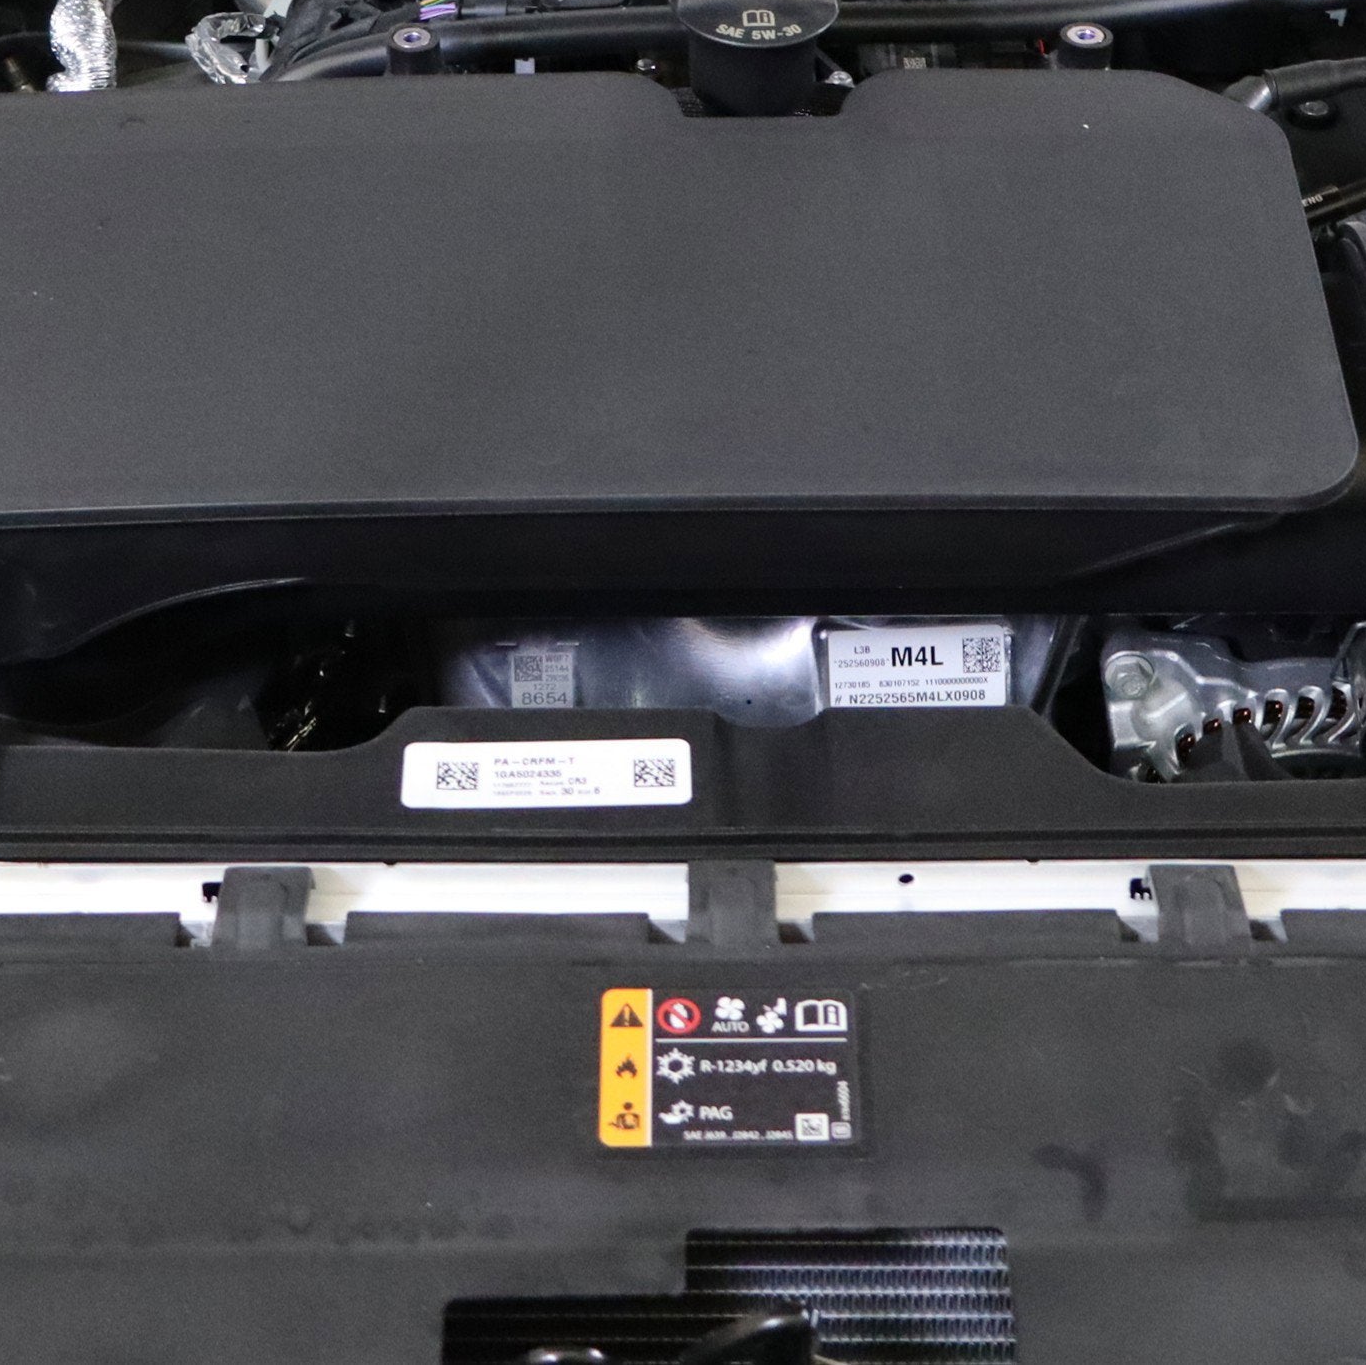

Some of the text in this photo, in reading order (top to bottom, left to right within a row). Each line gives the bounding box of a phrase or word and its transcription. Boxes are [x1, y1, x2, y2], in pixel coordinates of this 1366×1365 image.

[716, 24, 802, 40] SAE 5W-30
[854, 645, 870, 655] L3B
[891, 645, 944, 667] M4L
[521, 692, 568, 706] 8654
[849, 689, 986, 705] N2252565M4LX0908
[711, 1020, 750, 1033] AUTO
[699, 1059, 837, 1076] R-1234yf 0.520 kg
[699, 1106, 734, 1121] PAG
